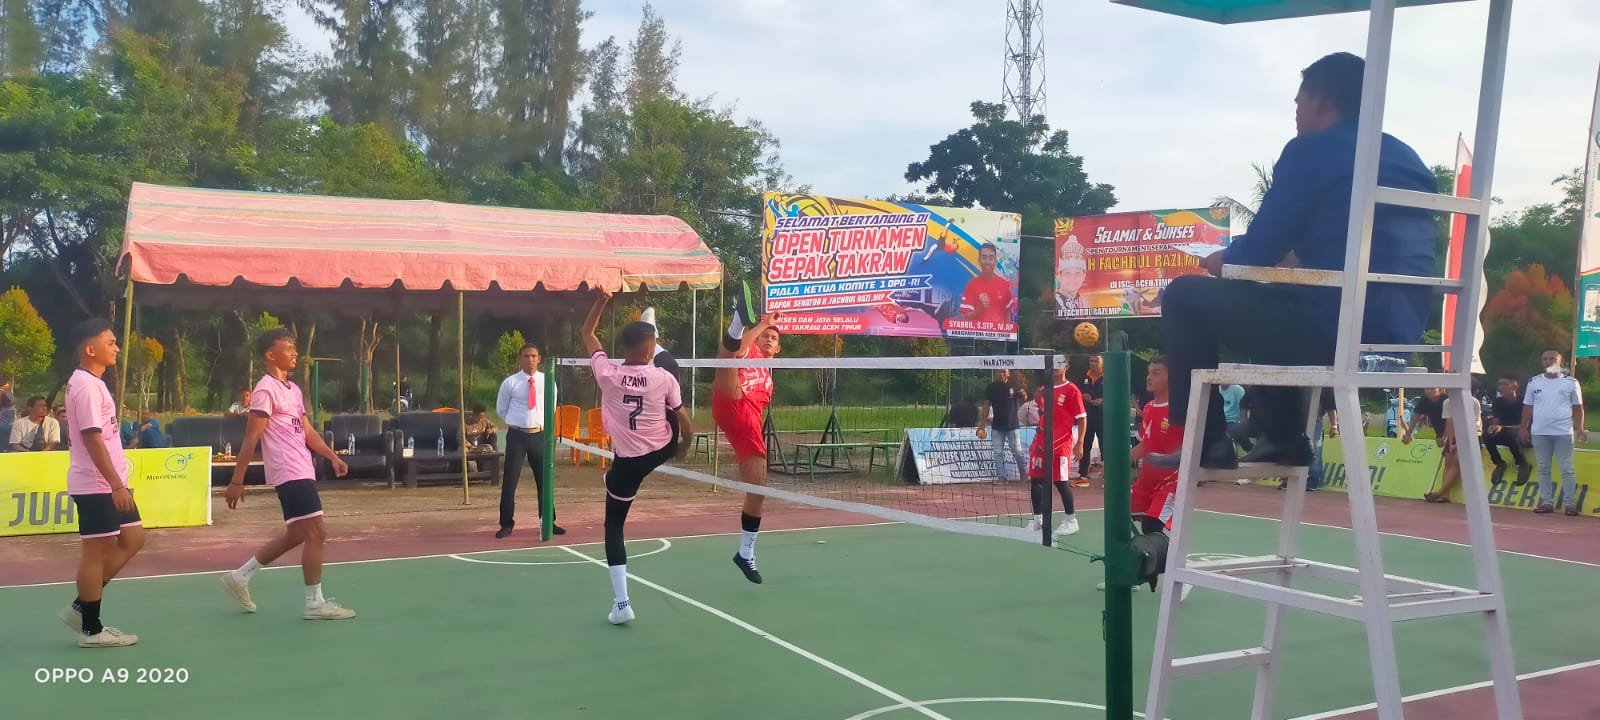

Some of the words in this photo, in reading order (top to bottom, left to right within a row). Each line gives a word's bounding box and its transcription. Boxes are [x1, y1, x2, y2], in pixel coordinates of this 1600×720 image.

[777, 215, 838, 228] SELAMAT
[840, 214, 915, 225] BERTANDING
[916, 213, 929, 223] DI
[1094, 226, 1142, 243] SELAMAT
[1142, 228, 1153, 241] &
[1154, 222, 1195, 239] SUKSES
[773, 230, 825, 256] OPEN
[830, 225, 926, 252] TURNAMEN
[1104, 245, 1150, 253] TOURNAMENT
[769, 255, 832, 281] SEPAK
[836, 251, 910, 277] TAKRAW
[1087, 258, 1095, 270] H
[1099, 254, 1151, 270] FACHRUL
[769, 286, 800, 297] PIALA
[803, 283, 837, 295] KETUA
[839, 281, 876, 291] KOMITE
[1136, 280, 1154, 288] ACEH
[1154, 278, 1173, 287] TIMU
[769, 301, 791, 310] BAPAK
[793, 299, 821, 308] SENATOR
[833, 315, 858, 323] SELALU
[791, 324, 821, 332] TAKRAW
[621, 376, 647, 388] AZAMI
[623, 395, 643, 430] 7
